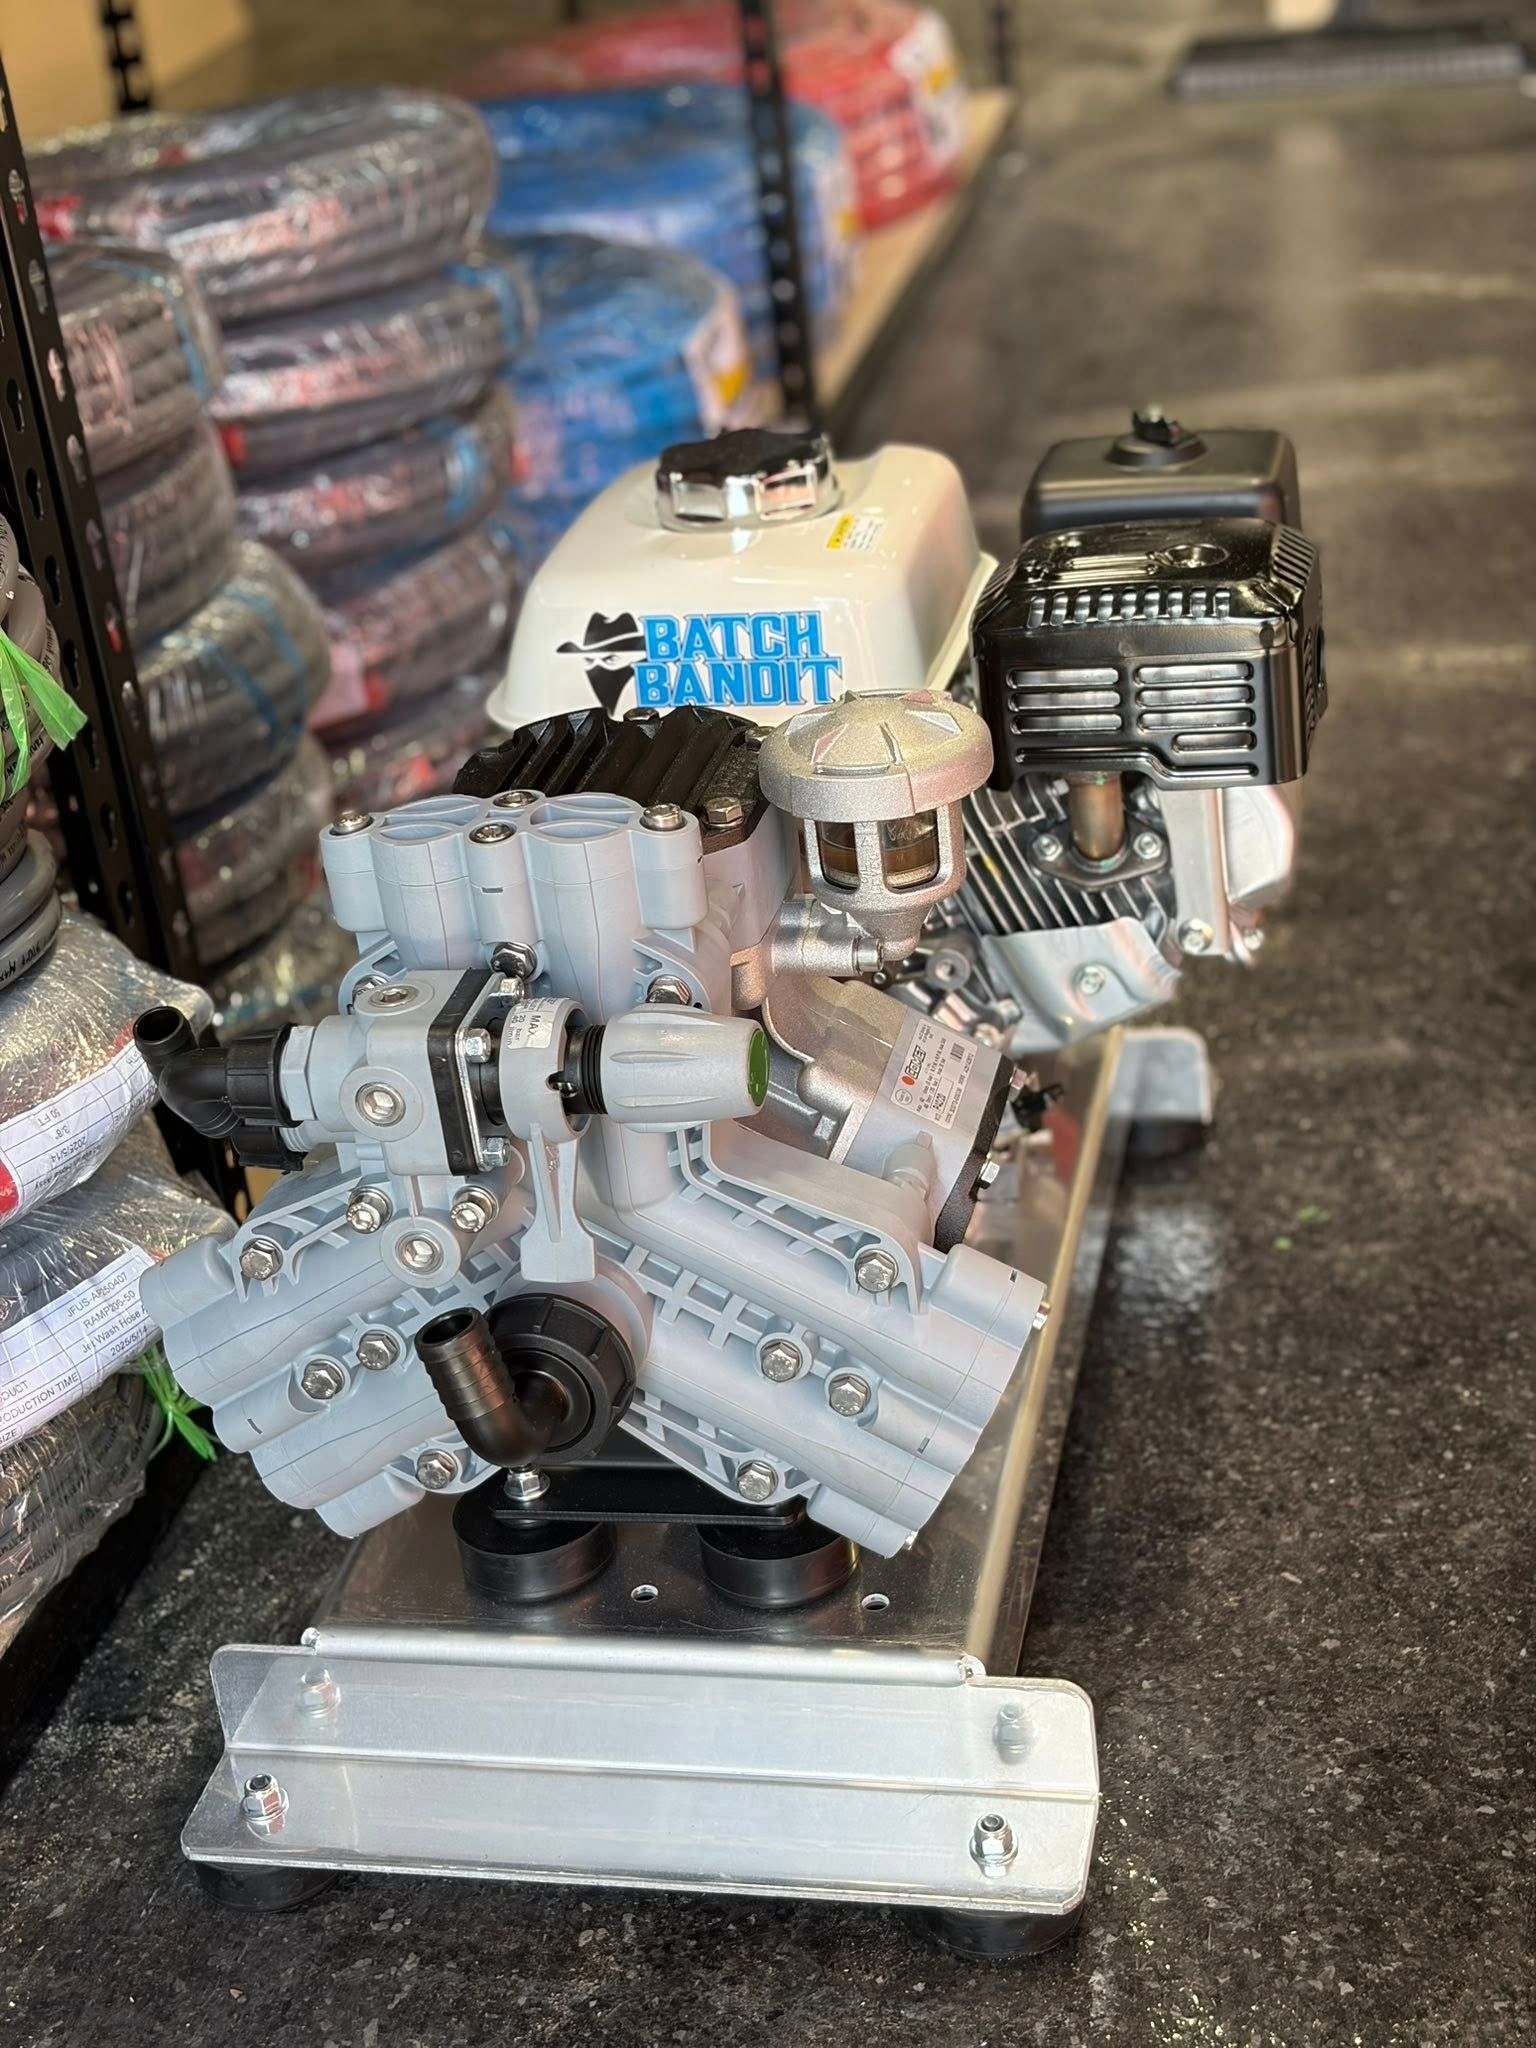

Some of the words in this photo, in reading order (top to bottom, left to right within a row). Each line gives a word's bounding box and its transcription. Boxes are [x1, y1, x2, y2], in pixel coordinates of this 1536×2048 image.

[640, 611, 829, 661] BATCH
[632, 656, 842, 707] BANDIT
[528, 1015, 541, 1037] MAX
[37, 1114, 51, 1126] FT
[96, 1323, 120, 1345] Wash
[119, 1310, 141, 1329] Hose
[110, 1326, 148, 1356] 2025/5/14
[55, 1373, 79, 1390] TIME
